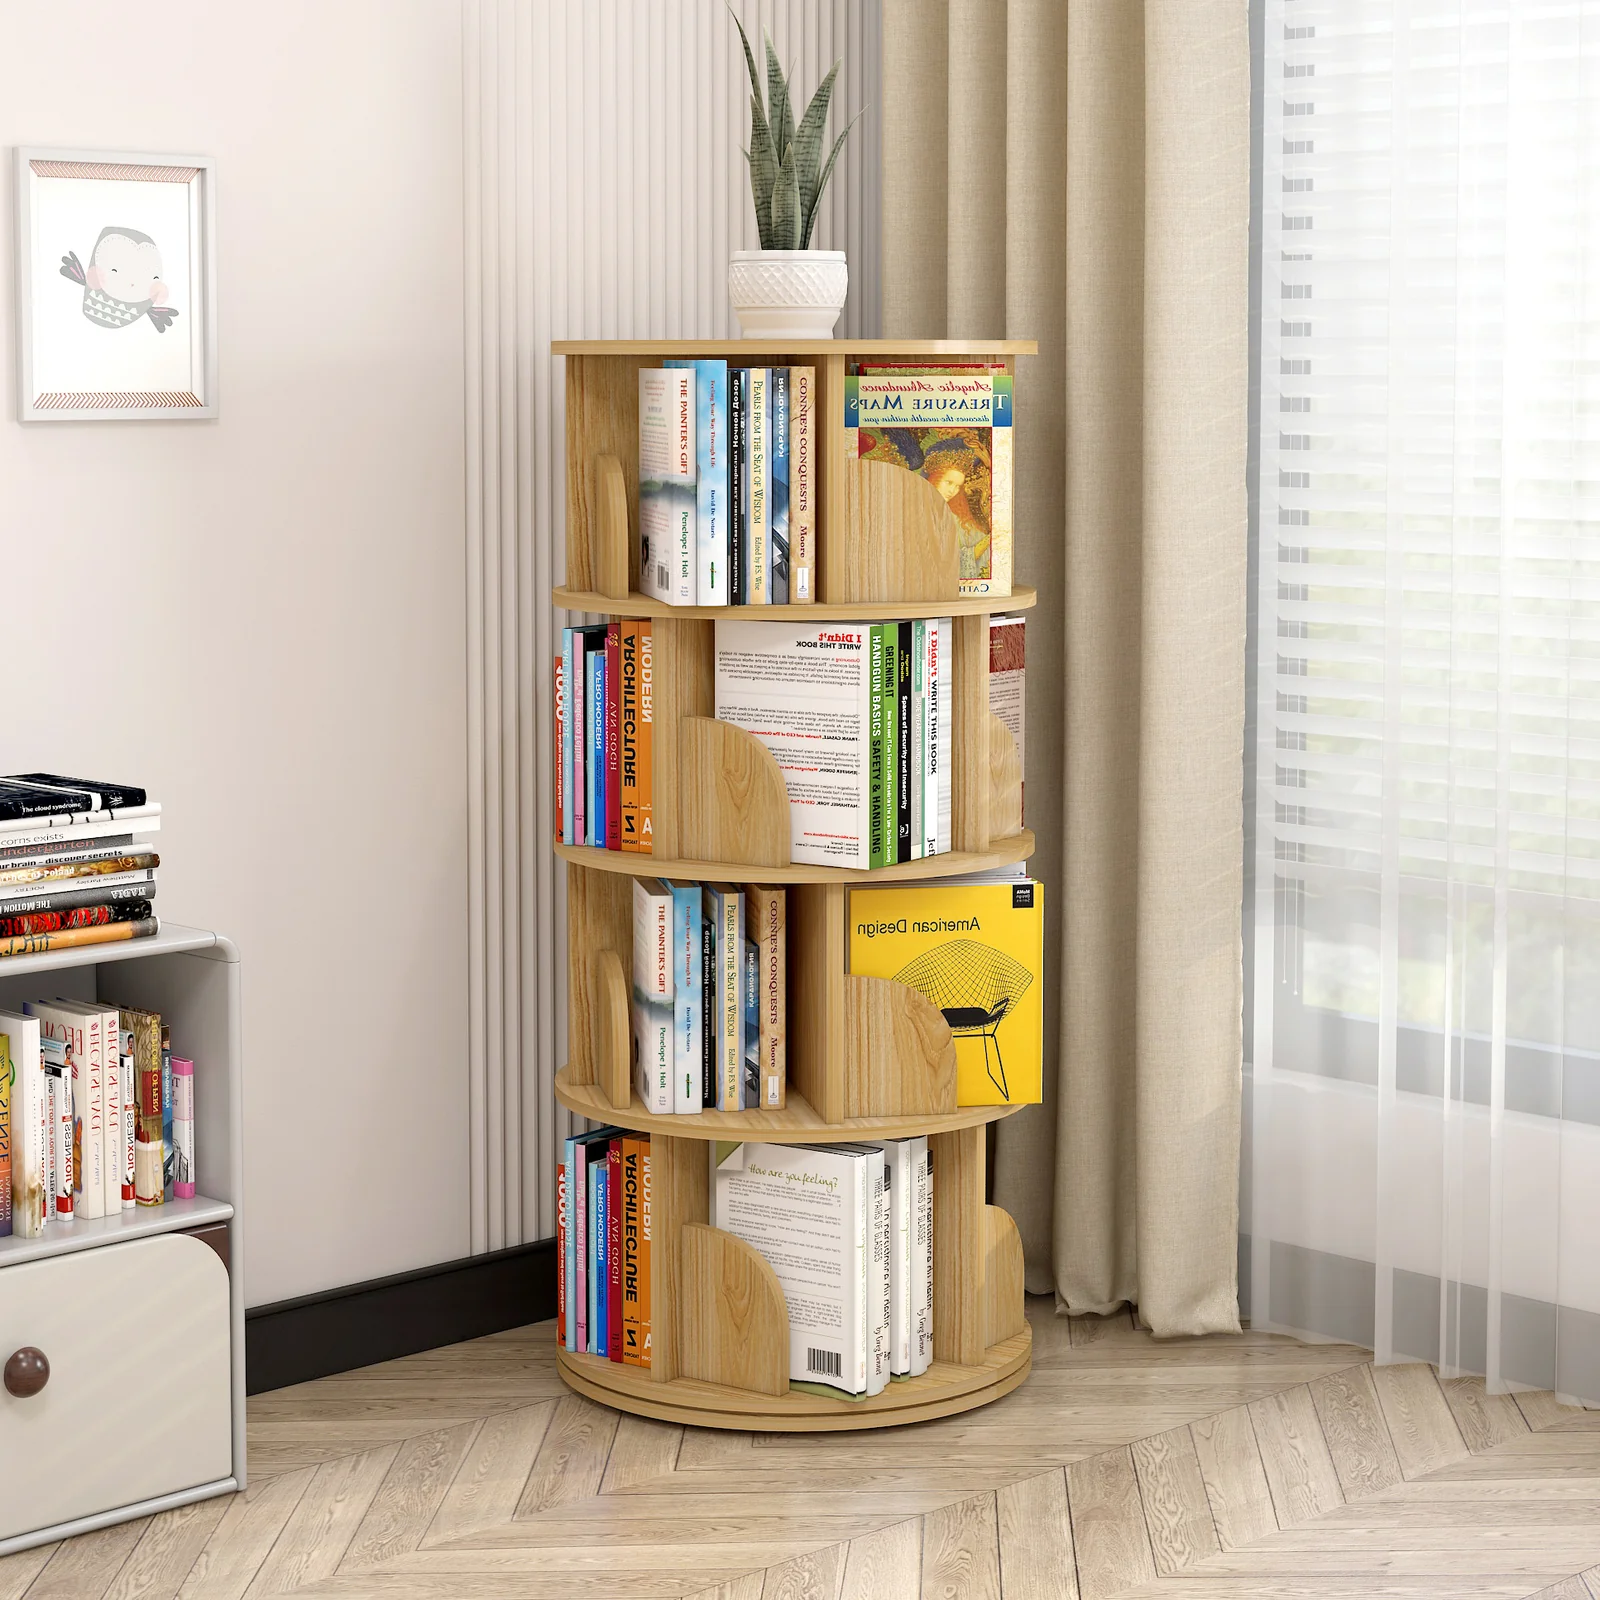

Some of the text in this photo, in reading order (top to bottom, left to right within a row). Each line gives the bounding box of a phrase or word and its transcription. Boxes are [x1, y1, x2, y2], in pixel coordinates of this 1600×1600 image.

[754, 380, 764, 410] PEARLS
[798, 377, 808, 511] CONNIE'S CONQUESTS
[754, 454, 764, 474] SEAT
[754, 476, 761, 486] OF
[710, 508, 716, 516] De
[754, 488, 764, 524] WISDOM
[680, 512, 688, 550] Penelope
[800, 526, 808, 558] Moore
[885, 646, 894, 698] GREENING IT
[872, 635, 882, 854] HANDGUN BASICS SAFETY & HANDLING
[34, 804, 52, 812] cloud
[34, 832, 64, 842] exists
[10, 850, 123, 869] brain discover secrets
[4, 900, 52, 914] THE MOTION
[110, 886, 148, 900] NADIA
[728, 904, 737, 932] PEARLS
[728, 972, 737, 990] SEAT
[768, 956, 778, 1025] CONQUESTS
[728, 992, 735, 1002] OF
[728, 1004, 737, 1037] WISDOM
[658, 1027, 666, 1062] Penelope
[748, 1164, 839, 1194] How are you feeling?
[918, 1160, 926, 1246] THREE PAIRS OF GLASSES
[874, 1176, 882, 1262] THREE PAIRS OF GLASSES
[918, 1307, 926, 1334] by Greg
